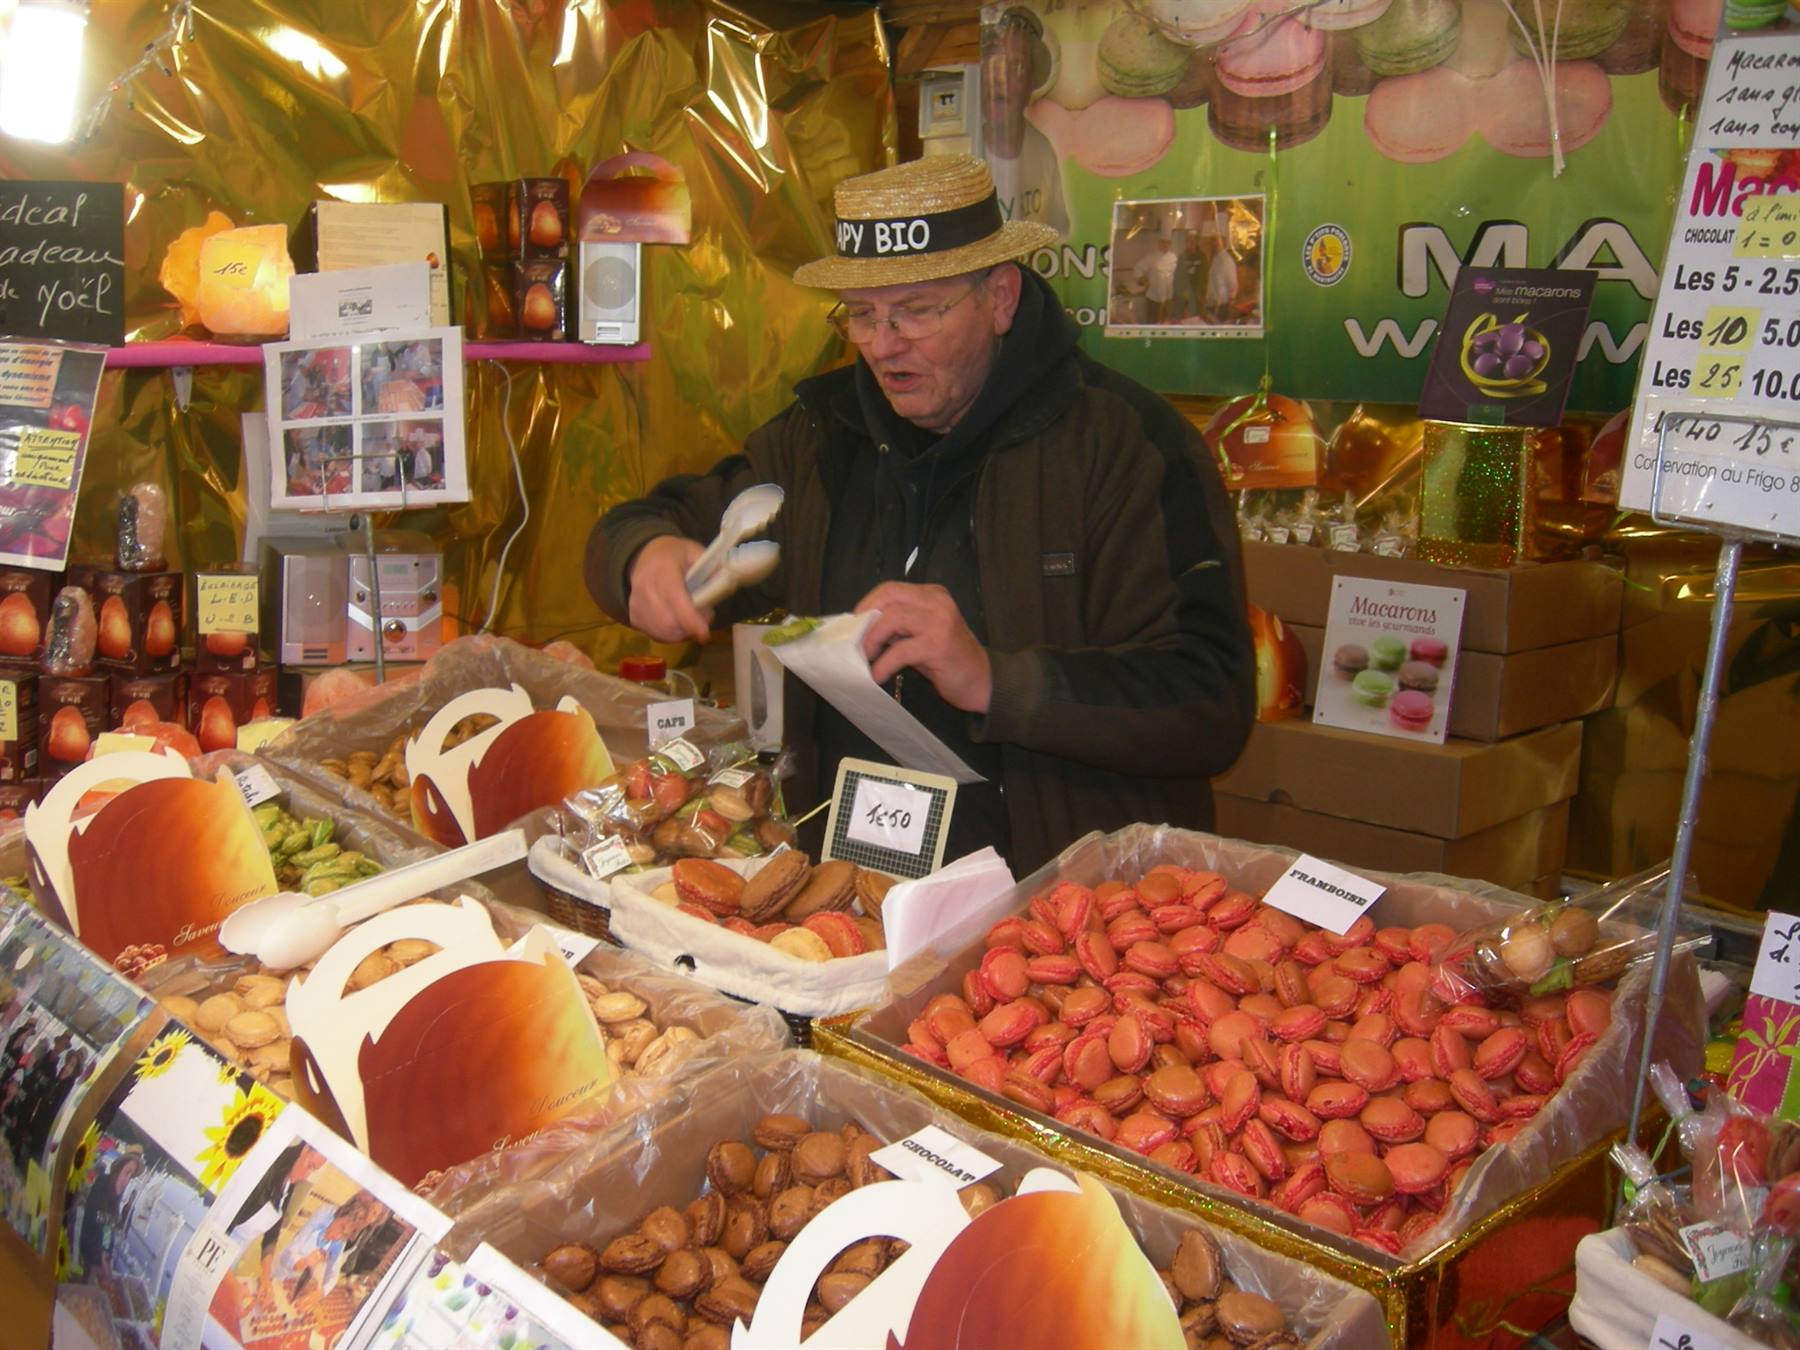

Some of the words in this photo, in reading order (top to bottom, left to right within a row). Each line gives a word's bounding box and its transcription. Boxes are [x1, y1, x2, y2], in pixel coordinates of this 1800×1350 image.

[875, 219, 930, 254] BIO
[1514, 286, 1581, 298] macarons
[1674, 264, 1716, 291] Les
[1722, 266, 1740, 292] 5
[1662, 312, 1704, 340] Les
[1707, 316, 1748, 346] 10
[1652, 361, 1692, 389] Les
[1721, 467, 1743, 484] au
[1746, 469, 1785, 493] Frigo
[1350, 597, 1437, 623] Macarons
[657, 716, 685, 729] CAFE
[1289, 869, 1368, 907] FRAMBOISE
[901, 1139, 977, 1182] CHOCOLAT
